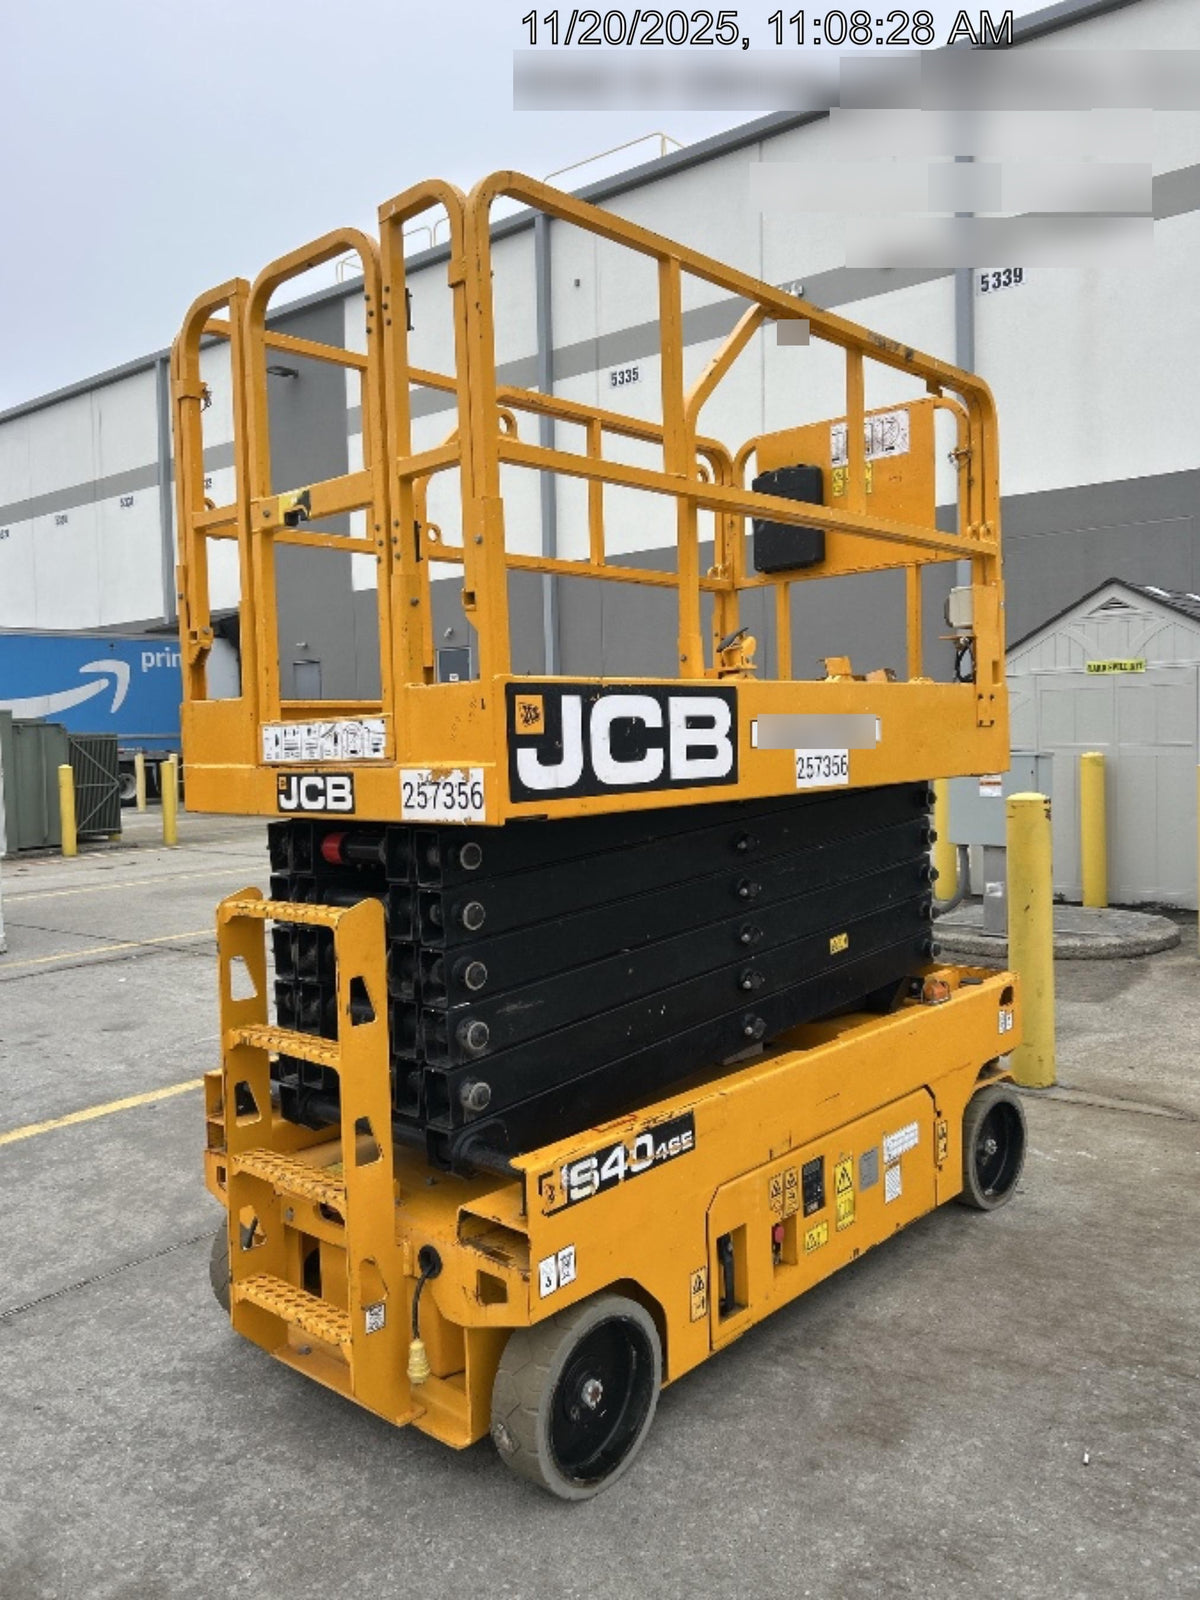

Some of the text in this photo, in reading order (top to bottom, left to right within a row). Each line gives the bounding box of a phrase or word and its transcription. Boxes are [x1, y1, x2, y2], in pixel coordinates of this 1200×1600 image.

[981, 267, 1023, 292] 5339
[611, 366, 639, 386] 5335
[516, 694, 734, 790] JCB
[796, 755, 849, 779] 257356
[278, 776, 353, 810] JCB
[402, 781, 484, 810] 257356
